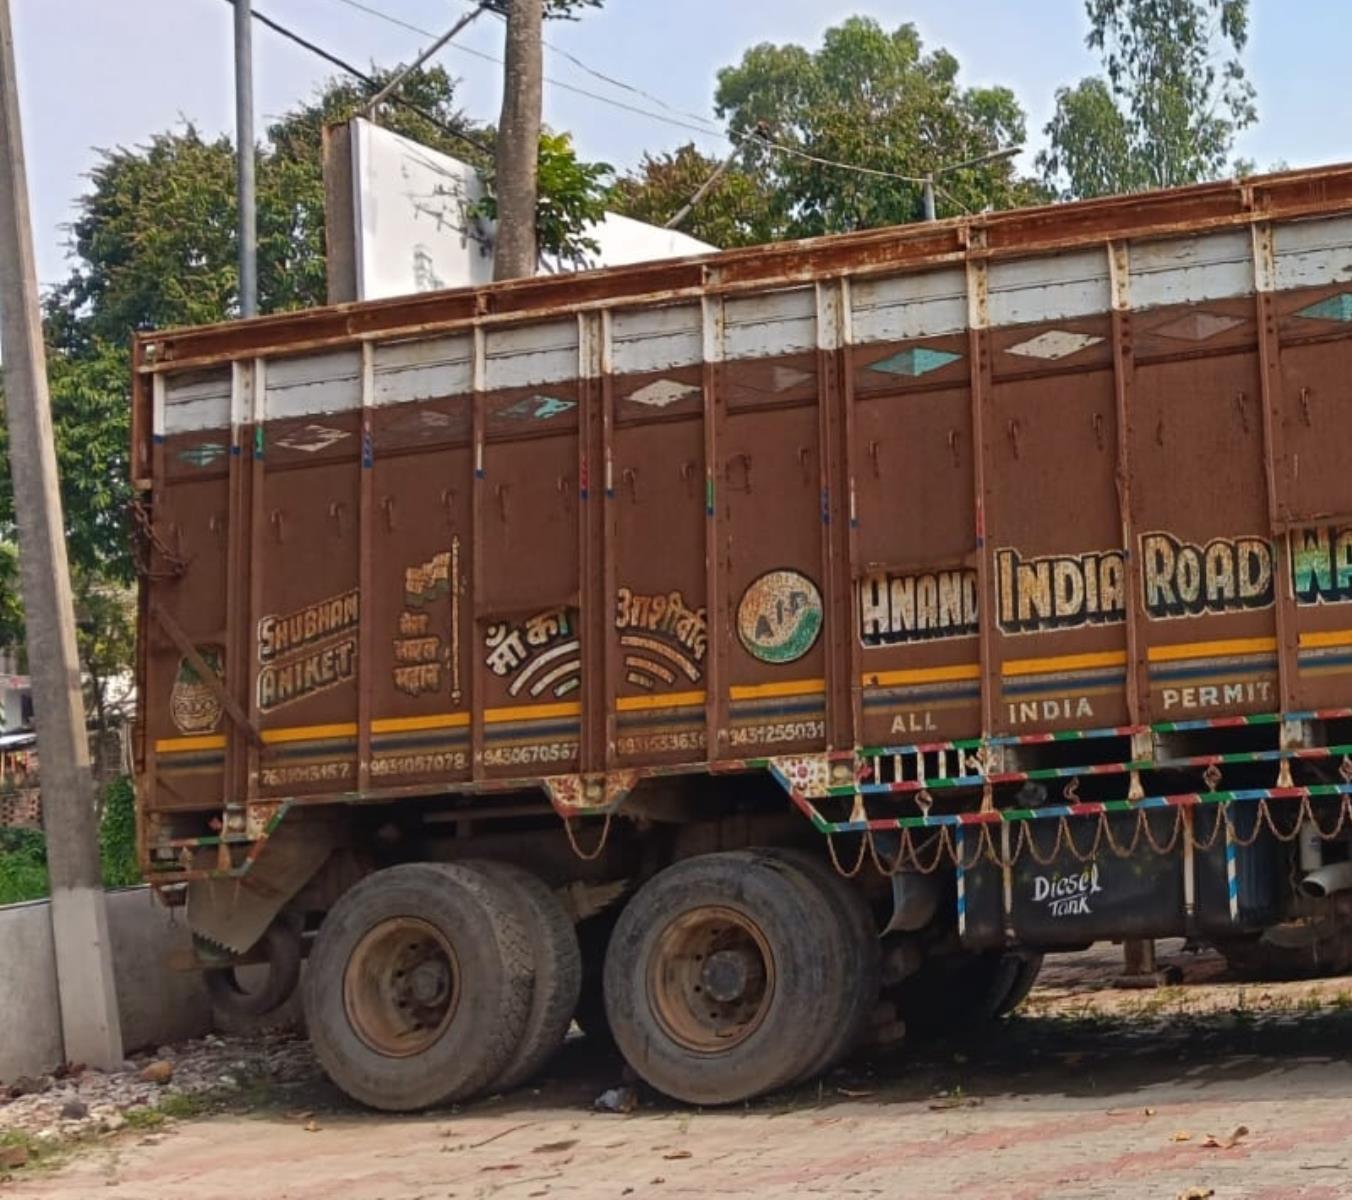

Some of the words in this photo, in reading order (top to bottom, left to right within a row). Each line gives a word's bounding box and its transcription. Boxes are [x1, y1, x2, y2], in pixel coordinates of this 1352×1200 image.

[859, 569, 979, 642] ANAND
[997, 549, 1125, 630] INDIA
[1143, 533, 1275, 614] ROAD
[526, 607, 568, 646] का
[259, 641, 355, 709] ANIKET
[891, 712, 937, 733] ALL
[1009, 697, 1093, 723] INDIA
[1163, 682, 1270, 709] PERMIT
[1032, 863, 1102, 902] Diesel
[1048, 896, 1092, 917] Tank
